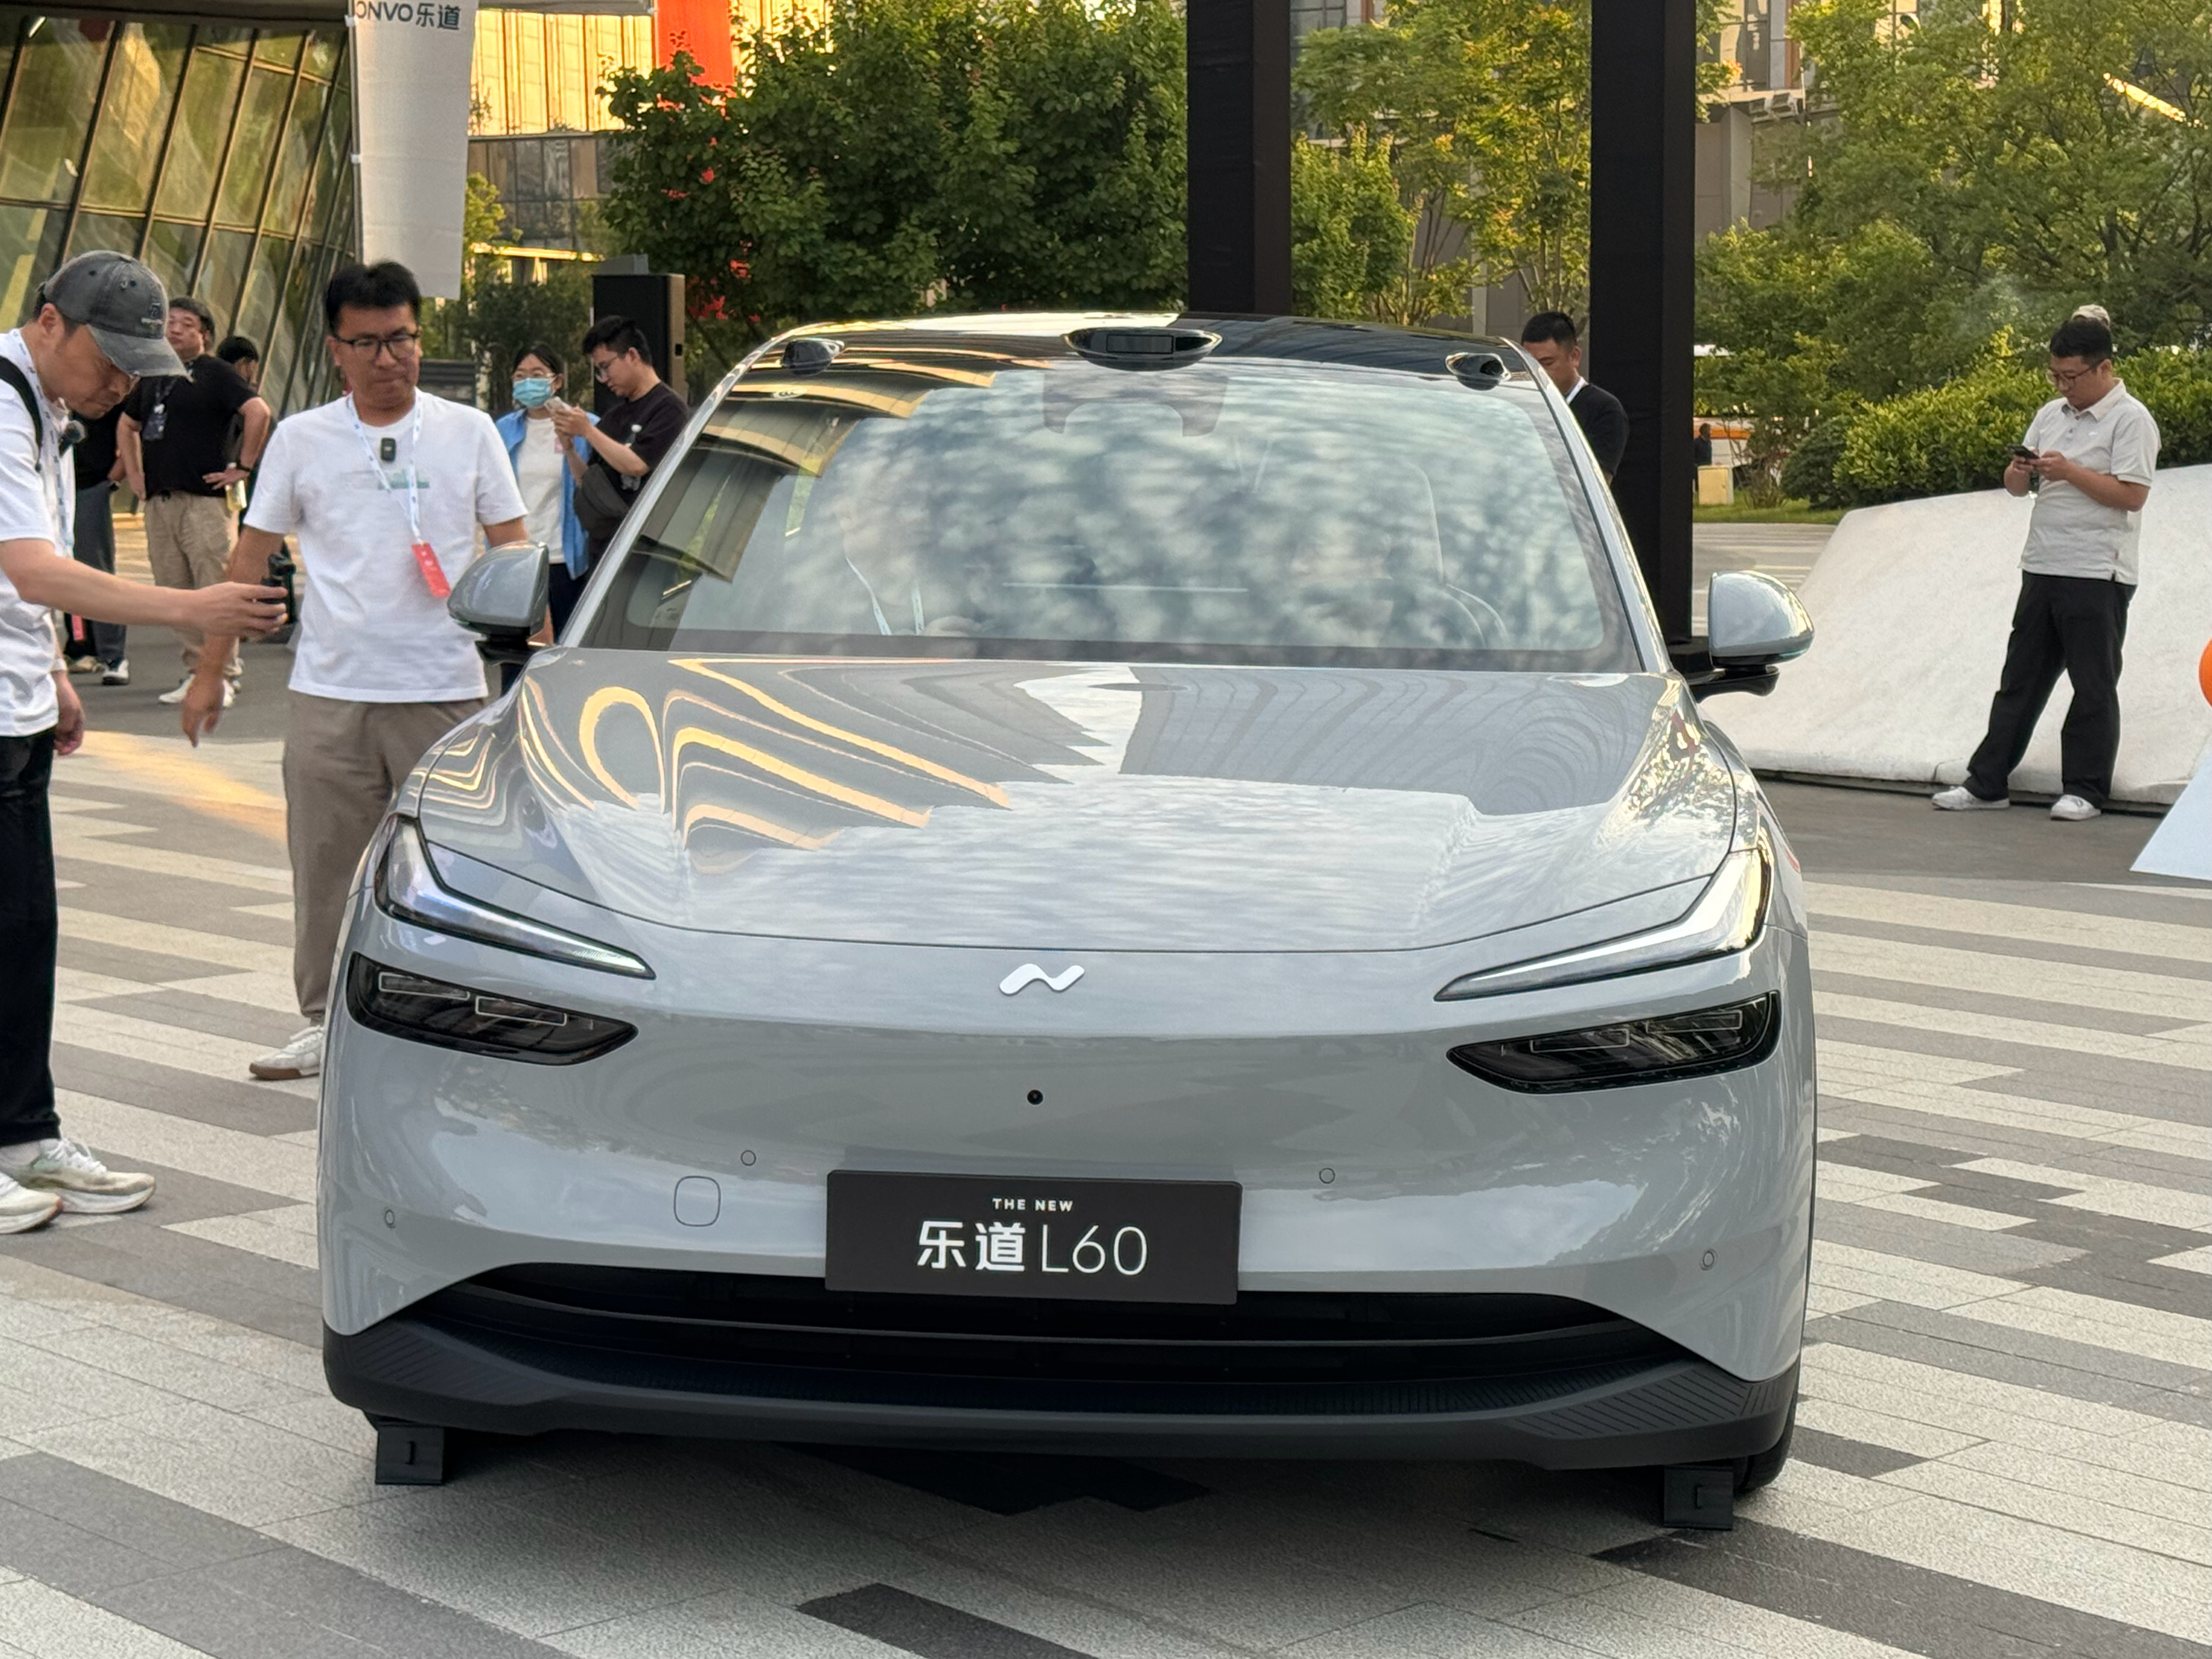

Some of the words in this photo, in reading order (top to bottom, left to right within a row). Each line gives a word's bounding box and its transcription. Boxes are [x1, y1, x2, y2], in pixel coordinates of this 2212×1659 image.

[416, 1, 460, 30] 乐道
[992, 1198, 1026, 1211] THE
[1035, 1199, 1074, 1212] NEW
[917, 1220, 1026, 1272] 乐道
[1042, 1223, 1147, 1276] L60
